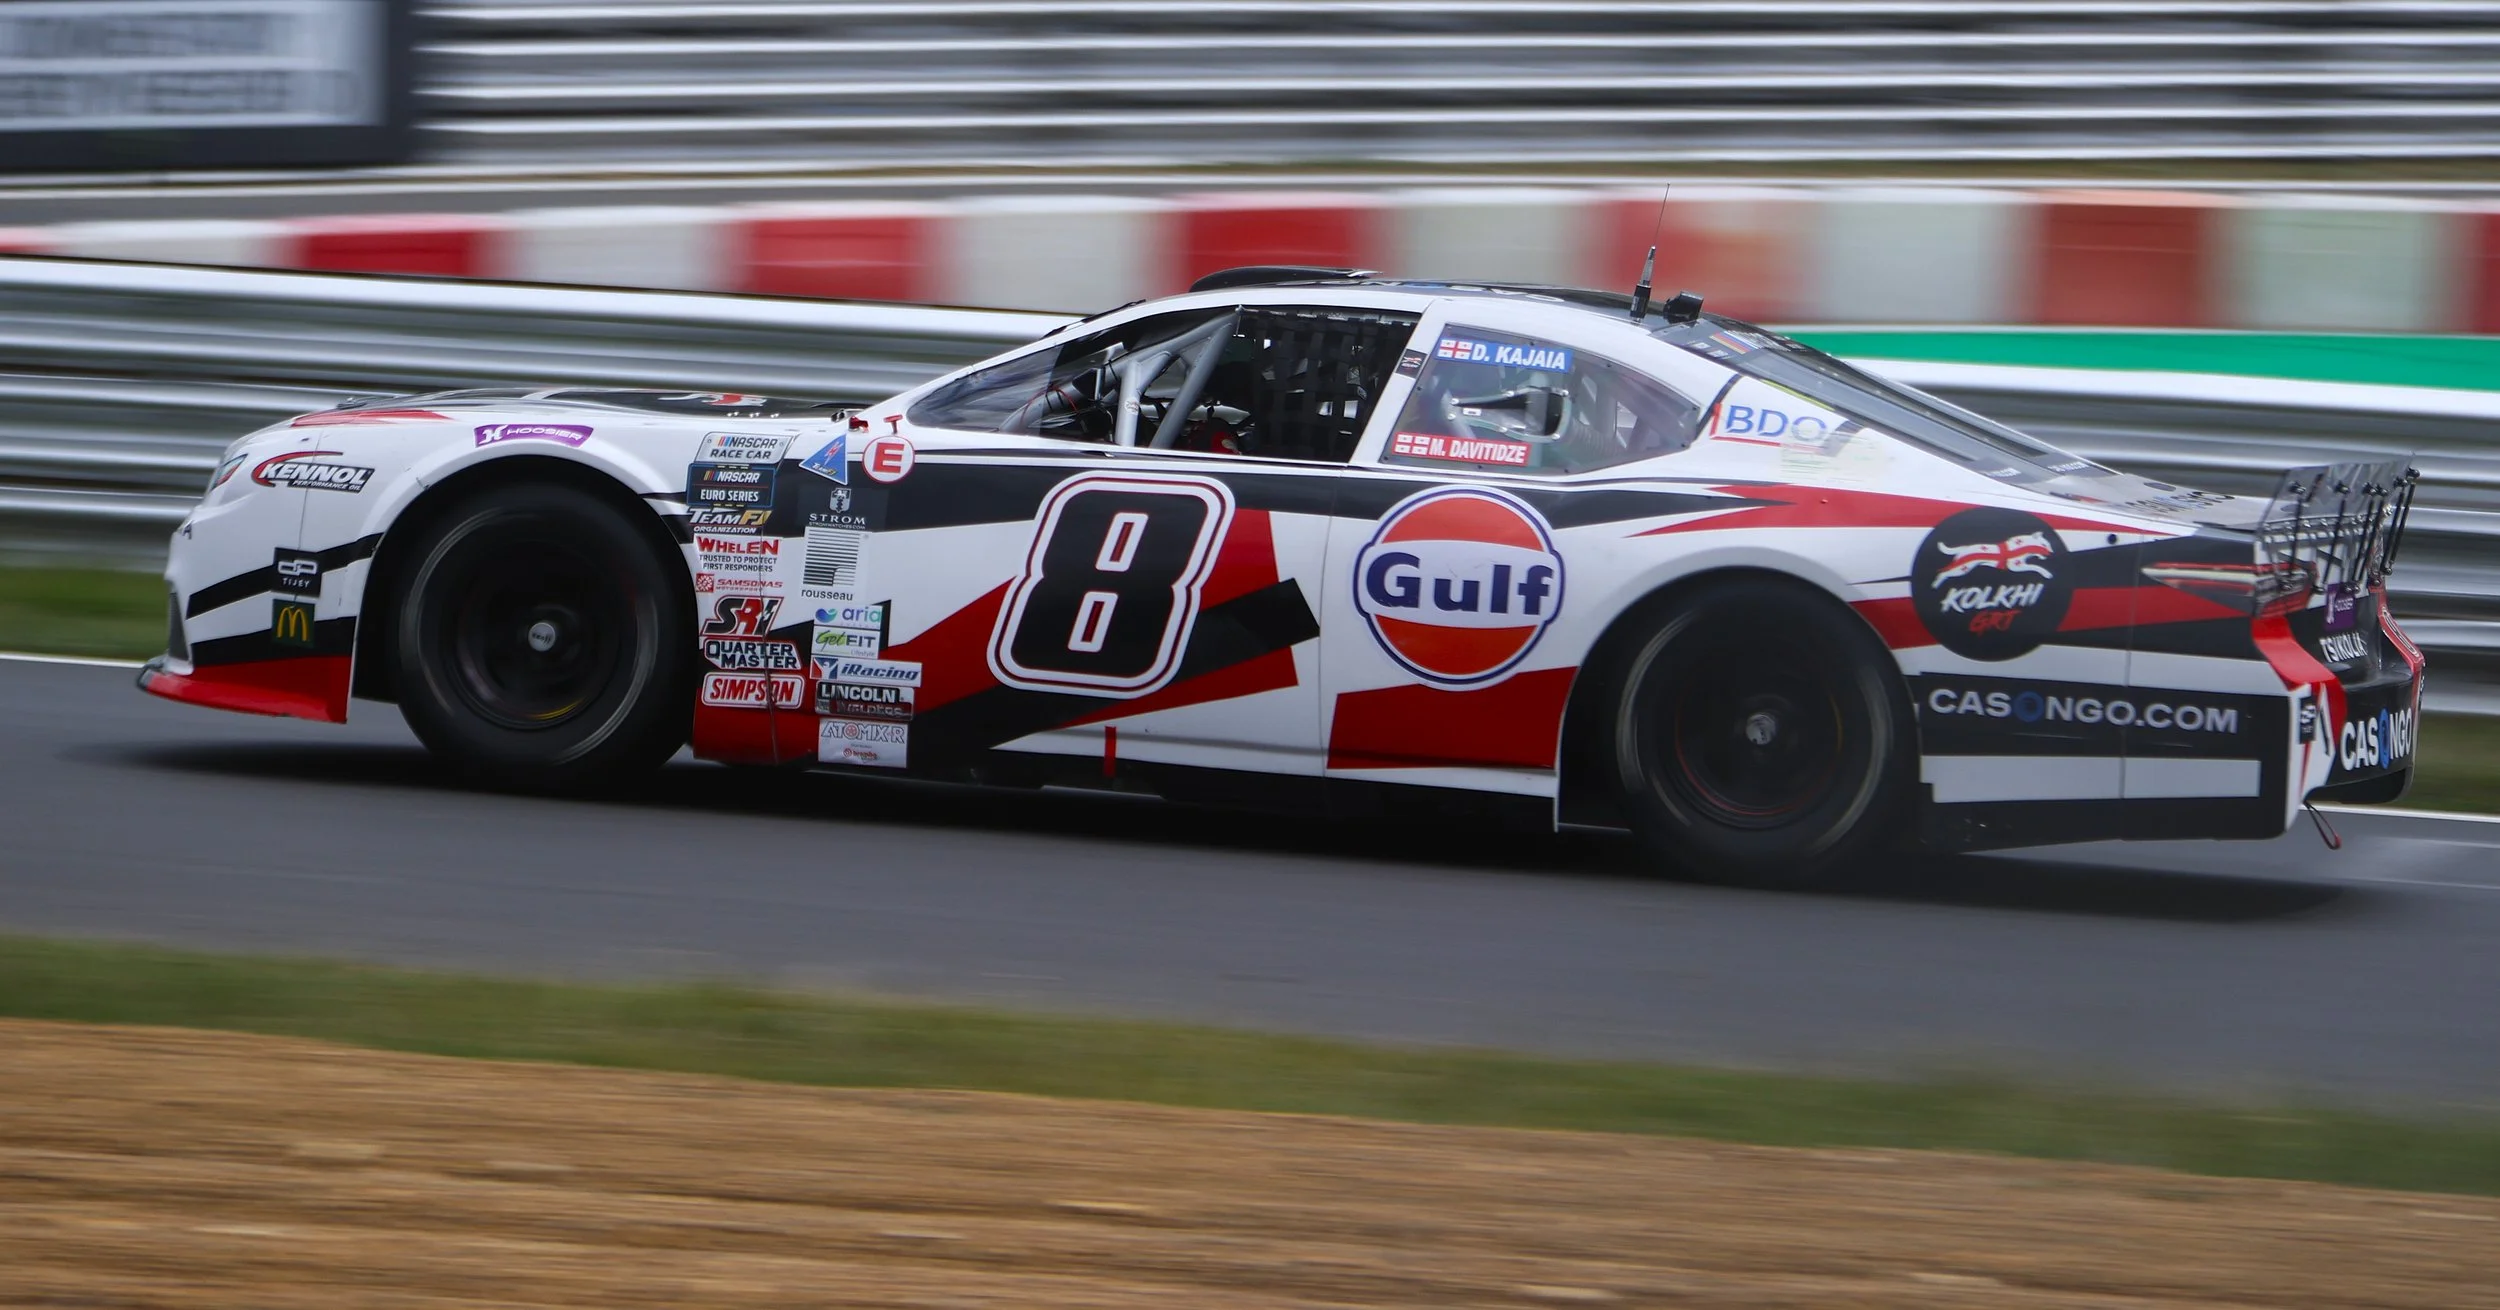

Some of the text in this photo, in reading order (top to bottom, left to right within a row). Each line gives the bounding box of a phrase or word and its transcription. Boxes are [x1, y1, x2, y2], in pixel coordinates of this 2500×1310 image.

[1472, 343, 1566, 370] D. KAJAIA
[1725, 404, 1827, 443] BDO
[506, 427, 584, 441] HOOSIER
[728, 436, 778, 449] NASCAR
[710, 449, 772, 460] RACE CAR
[873, 442, 905, 474] E
[1428, 438, 1527, 464] M. DAVITIDZE
[258, 463, 367, 485] KENNOL
[716, 471, 761, 483] NASCAR
[292, 480, 361, 491] PERFORMANCE OIL
[700, 489, 759, 502] EURO SERIES
[809, 513, 866, 525] STROM
[693, 525, 757, 534] ORGANIZATION
[696, 536, 780, 556] WHELEN
[699, 554, 732, 563] TRUSTED
[744, 556, 778, 565] PROTECT
[703, 562, 773, 572] FIRST RESPONDERS
[282, 577, 310, 588] TIJEY
[716, 578, 783, 588] SAMSONAS
[994, 475, 1231, 694] 8
[1365, 551, 1554, 616] Gulf
[801, 588, 854, 601] rousseau
[1940, 583, 2045, 613] KOLKHI
[842, 606, 881, 623] aria
[706, 640, 794, 659] QUARTER
[720, 653, 798, 669] MASTER
[841, 663, 920, 681] iRacing
[710, 678, 796, 703] SIMPSON
[821, 684, 897, 703] LINCOLN
[1928, 688, 2238, 734] CASONGO.COM
[2341, 707, 2413, 771] CASONGO
